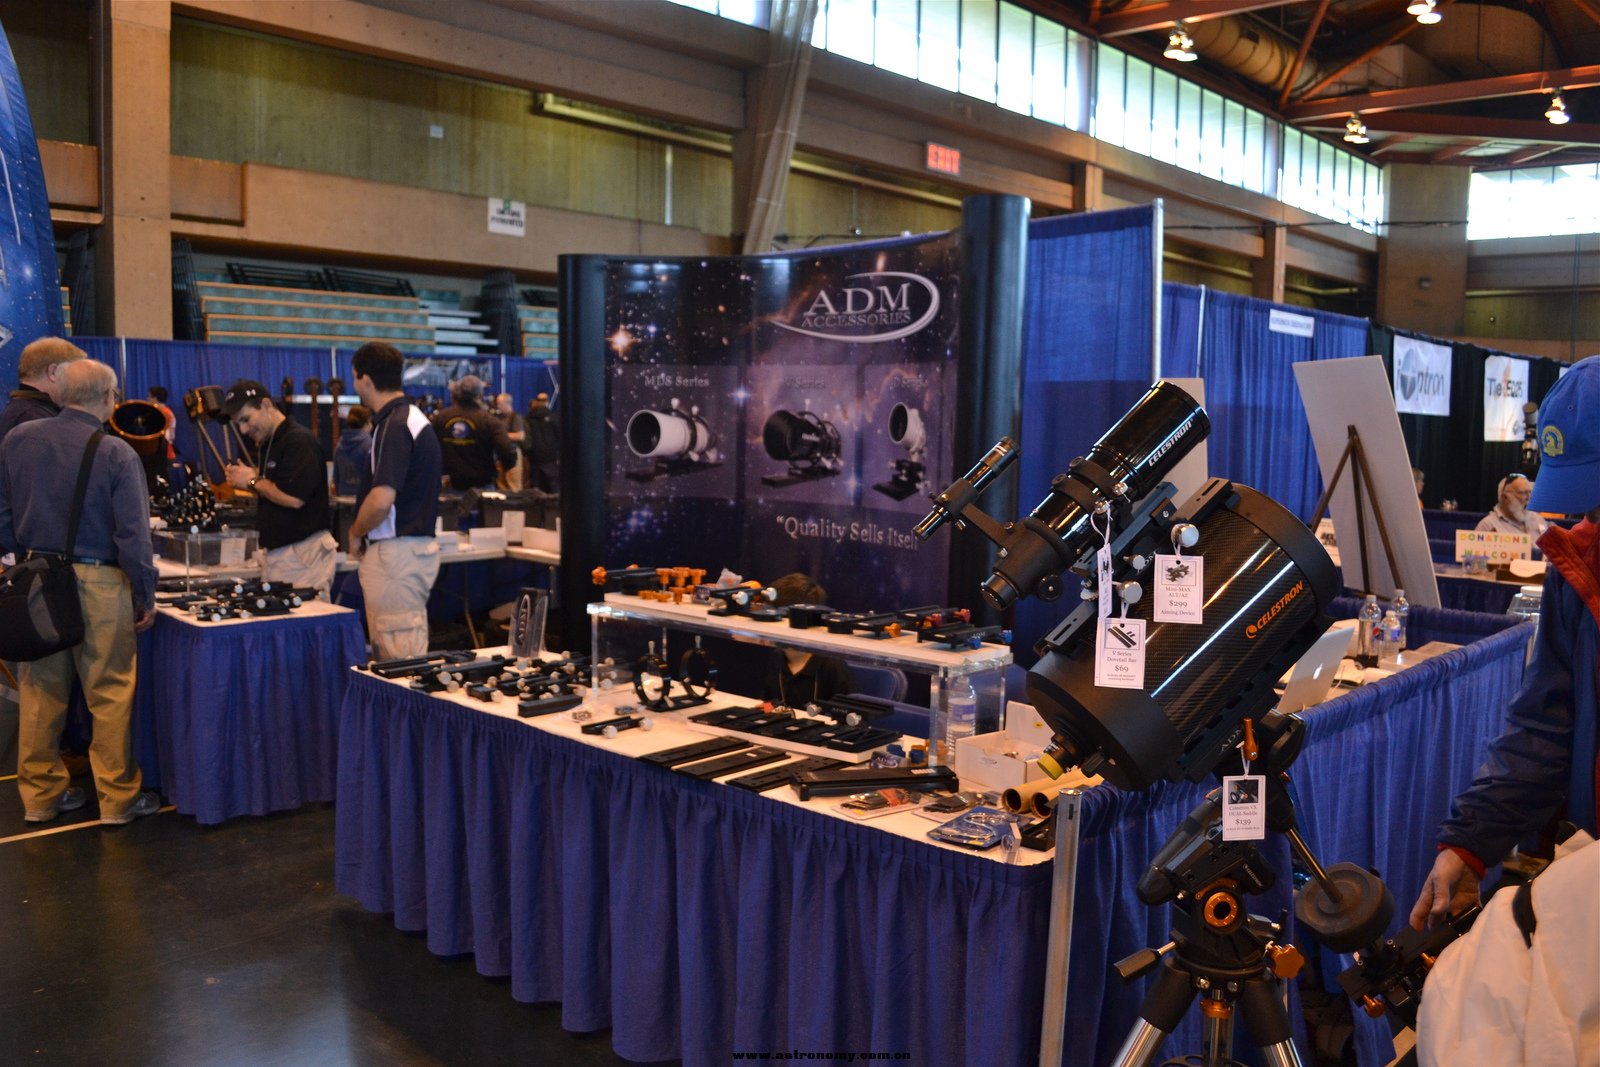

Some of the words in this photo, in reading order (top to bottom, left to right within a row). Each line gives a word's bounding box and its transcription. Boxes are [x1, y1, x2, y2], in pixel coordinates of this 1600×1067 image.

[928, 144, 960, 174] EXIT
[802, 282, 912, 316] ADM
[801, 311, 912, 328] ACCESSORIES
[644, 375, 673, 387] MDS
[675, 375, 710, 387] Series
[1148, 420, 1193, 467] CELESTRON
[850, 521, 884, 545] Sells
[1460, 533, 1529, 544] DONATIONS
[1169, 600, 1188, 608] $299
[1256, 580, 1304, 630] CELESTRON
[1114, 665, 1129, 673] $69
[1235, 818, 1252, 826] $139
